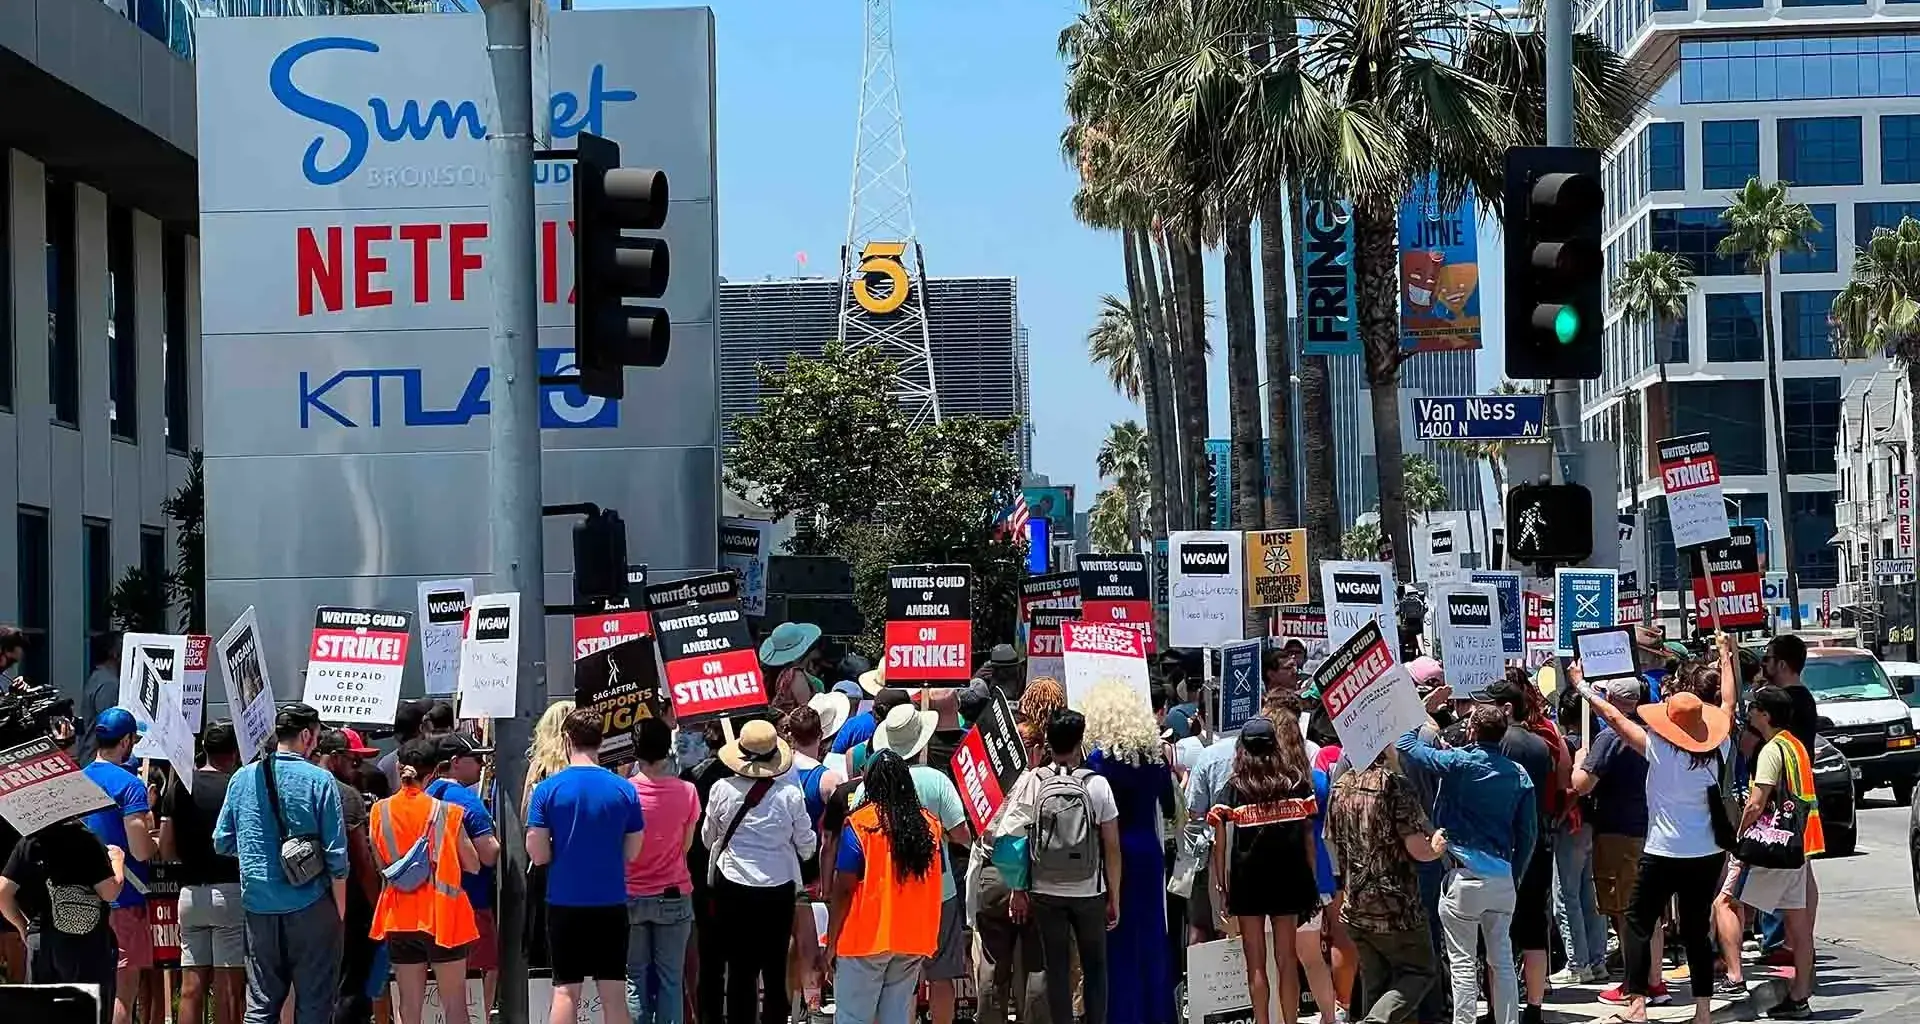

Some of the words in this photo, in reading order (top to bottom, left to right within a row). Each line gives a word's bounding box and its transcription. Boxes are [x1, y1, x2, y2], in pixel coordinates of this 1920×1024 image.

[269, 37, 637, 186] Sunet
[1411, 219, 1465, 248] JUNE
[297, 221, 576, 316] NETFI
[1306, 196, 1347, 341] FRING
[853, 242, 909, 314] 5
[1420, 399, 1454, 420] Van
[1466, 399, 1516, 420] Ness
[1420, 421, 1452, 437] 1400
[1459, 421, 1468, 436] N
[1523, 420, 1538, 435] Av
[1661, 444, 1690, 459] WRITERS
[1690, 441, 1710, 453] GUILD
[1665, 461, 1715, 489] STRIKE!
[1900, 479, 1909, 508] FOR
[1261, 532, 1292, 545] IATSE
[1900, 515, 1911, 554] RENT
[1182, 553, 1228, 565] WGAW
[1720, 550, 1728, 558] OF
[1081, 561, 1118, 571] WRITERS
[1119, 561, 1143, 571] GUILD
[1886, 562, 1913, 573] Moritz
[892, 577, 935, 589] WRITERS
[936, 576, 965, 588] GUILD
[1109, 574, 1118, 583] OF
[650, 585, 697, 605] WRITERS
[699, 581, 731, 597] GUILD
[1024, 580, 1062, 594] WRITERS
[1097, 586, 1134, 597] AMERICA
[1256, 584, 1300, 595] WORKERS
[1335, 582, 1381, 595] WGAW
[1721, 580, 1736, 593] ON
[922, 591, 934, 601] OF
[1264, 593, 1296, 604] RIGHTS
[429, 601, 465, 614] WGAW
[905, 604, 950, 616] AMERICA
[1112, 607, 1127, 619] ON
[1450, 604, 1489, 616] WGAW
[322, 611, 371, 625] WRITERS
[372, 613, 406, 627] GUILD
[478, 617, 508, 630] WGAW
[603, 619, 619, 633] ON
[659, 611, 708, 632] WRITERS
[708, 610, 740, 622] GUILD
[1333, 609, 1361, 628] RUN
[355, 627, 367, 635] ON
[696, 627, 708, 638] OF
[919, 628, 936, 641] ON
[1070, 624, 1134, 639] WRITERS
[228, 635, 254, 671] WGAW
[316, 635, 401, 661] STRIKE!
[682, 638, 731, 655] AMERICA
[1070, 640, 1138, 655] AMERICA
[889, 644, 966, 668] STRIKE!
[1318, 652, 1353, 687] WRITERS
[1352, 630, 1376, 655] GUILD
[150, 657, 172, 671] GAW
[703, 661, 723, 675] ON
[319, 670, 386, 681] OVERPAID:
[1328, 648, 1387, 715] STRIKE!
[337, 682, 364, 691] CEO
[592, 682, 638, 701] SAG-AFTRA
[674, 671, 760, 705] STRIKE!
[315, 694, 383, 705] UNDERPAID:
[597, 688, 653, 713] PPORTS
[322, 705, 372, 715] WRITER
[992, 698, 1011, 743] WRITERS
[1006, 740, 1021, 770] GUILD
[14, 741, 51, 761] GUILD
[995, 737, 1004, 750] OF
[984, 732, 1004, 777] AMERICA
[0, 756, 72, 792] TRIKE!
[957, 745, 993, 824] STRIKE!
[156, 905, 171, 920] ON
